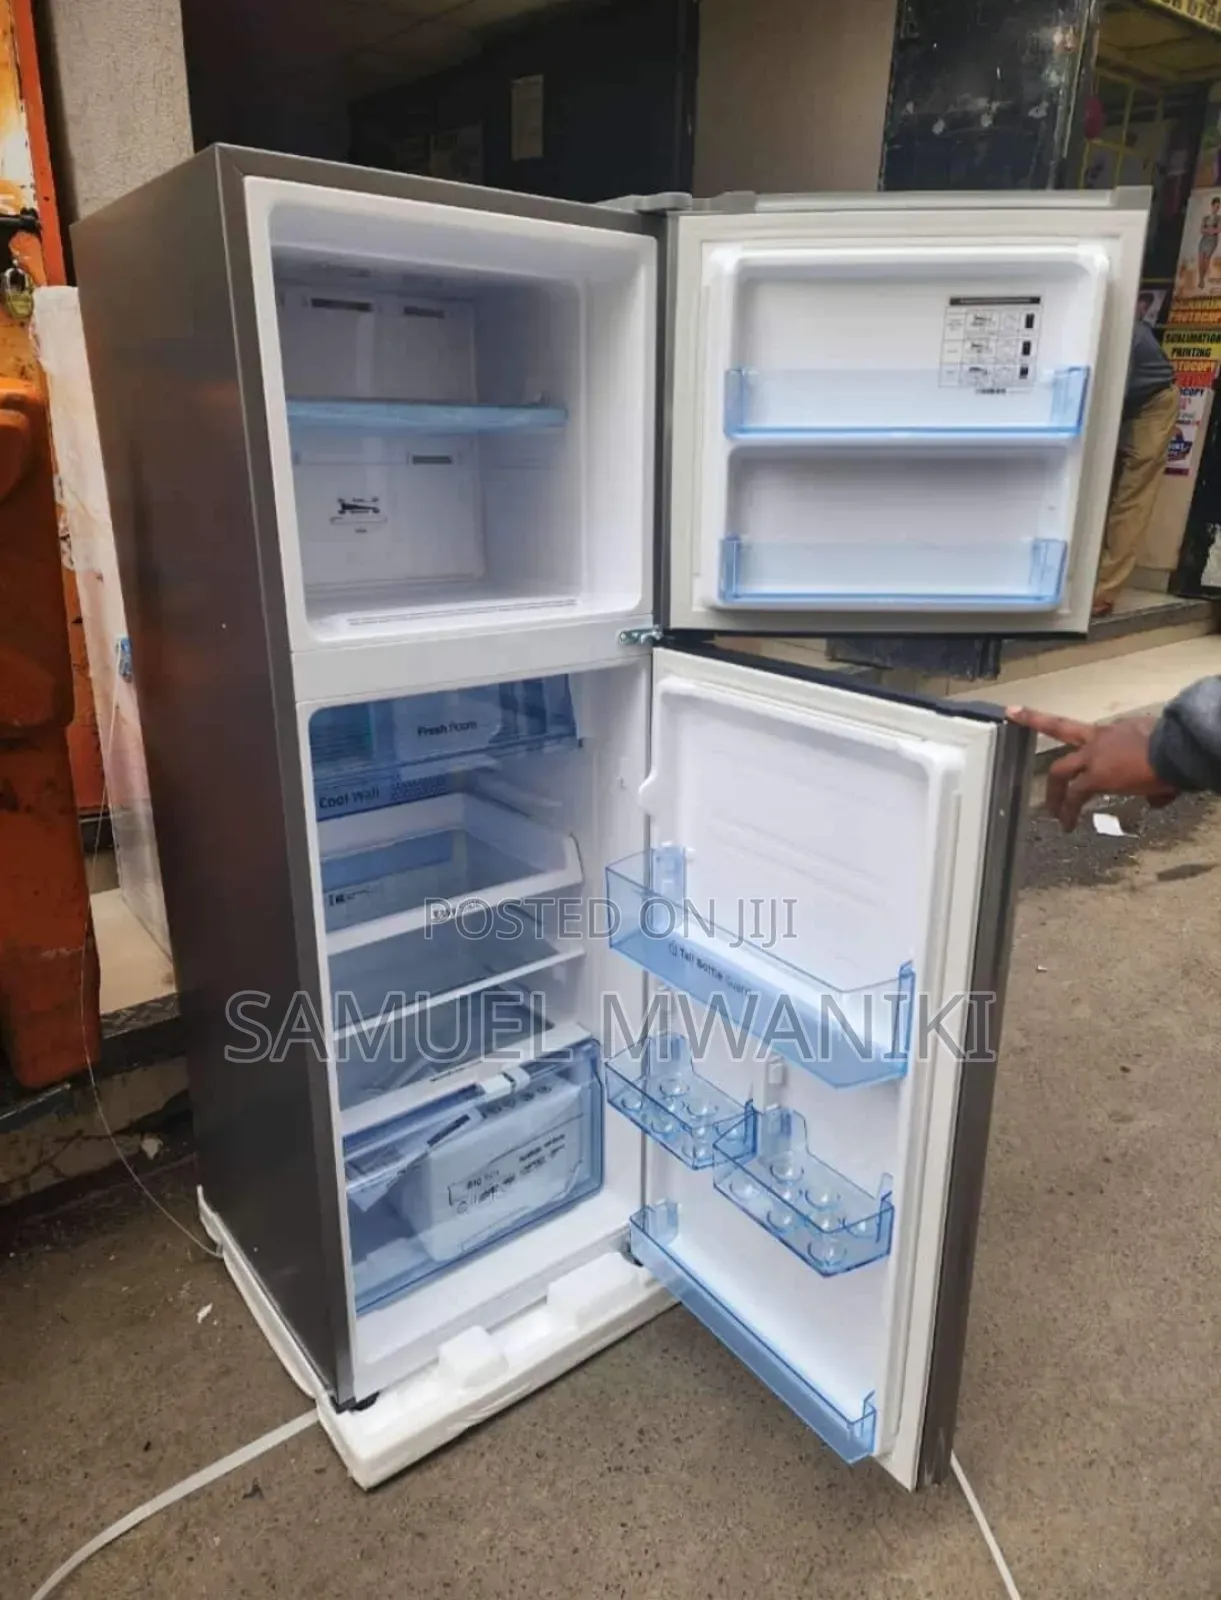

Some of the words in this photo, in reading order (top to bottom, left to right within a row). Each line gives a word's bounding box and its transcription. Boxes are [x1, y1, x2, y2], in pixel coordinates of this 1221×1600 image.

[1171, 347, 1212, 358] PRINTING
[417, 724, 448, 737] Fresh
[319, 793, 348, 809] Cool
[679, 946, 694, 963] Tall
